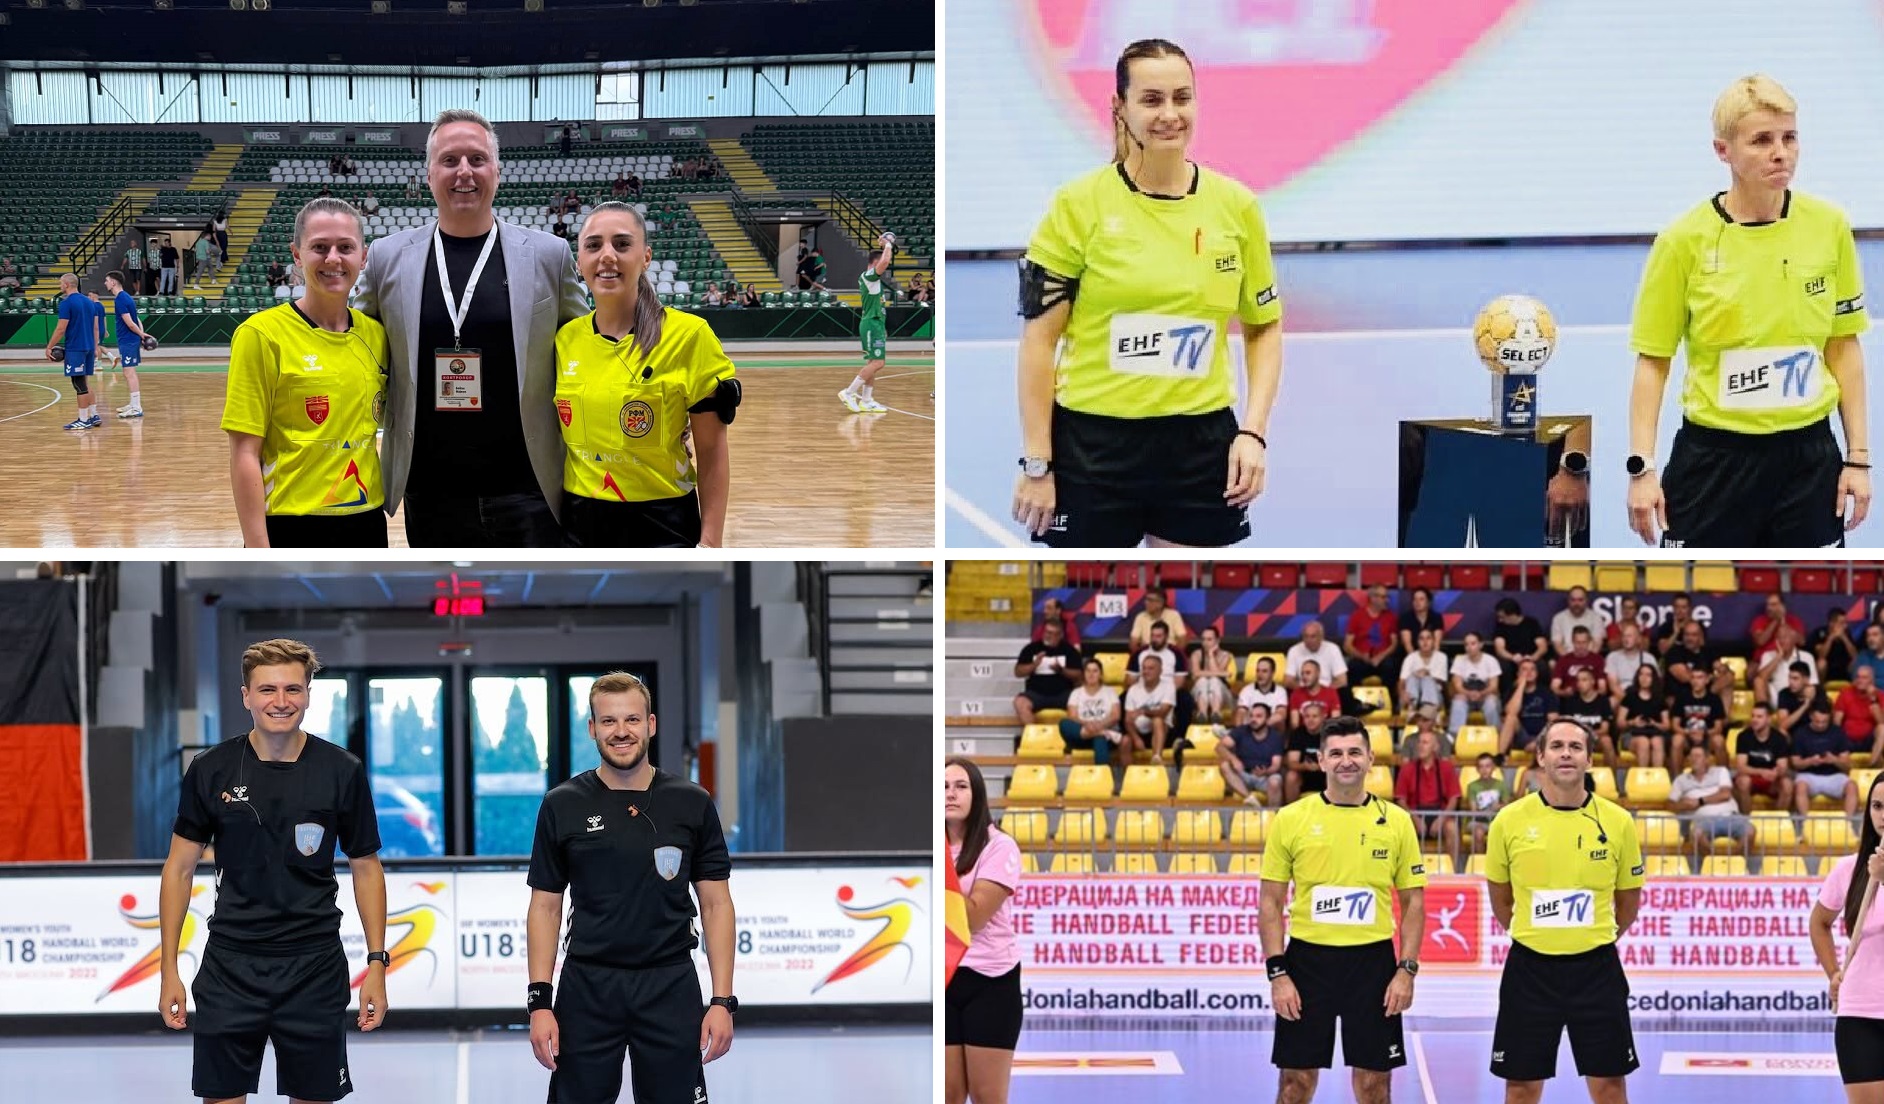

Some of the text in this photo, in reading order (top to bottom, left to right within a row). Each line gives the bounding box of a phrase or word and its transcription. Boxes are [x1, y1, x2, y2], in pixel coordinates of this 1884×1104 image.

[253, 131, 280, 141] PRESS
[309, 131, 336, 141] PRESS
[364, 132, 391, 142] PRESS
[611, 128, 638, 138] PRESS
[669, 127, 696, 136] PRESS
[1215, 255, 1236, 269] EHF
[1804, 276, 1825, 293] EHF
[1118, 324, 1213, 370] EHF TV
[1501, 346, 1548, 361] SELECT
[1727, 351, 1815, 397] EHF TV
[1100, 602, 1123, 615] M3
[973, 665, 990, 675] VII
[966, 703, 979, 713] VI
[960, 742, 968, 751] V
[1372, 849, 1388, 857] EHF
[1590, 850, 1608, 859] EHF
[1146, 886, 1177, 906] НА
[1782, 888, 1810, 908] НА
[1316, 891, 1373, 920] EHF TV
[1535, 893, 1590, 921] EHF TV
[1052, 914, 1173, 934] HANDBALL
[1689, 916, 1809, 936] HANDBALL
[759, 929, 855, 939] HANDBALL WORLD
[42, 938, 139, 948] HANDBALL WORLD
[461, 933, 514, 957] U18
[759, 944, 841, 954] CHAMPIONSHIP
[42, 953, 125, 963] CHAMPIONSHIP
[1034, 943, 1163, 963] HANDBALL
[1671, 945, 1800, 965] HANDBALL
[784, 959, 815, 970] 2022
[69, 967, 98, 979] 2022
